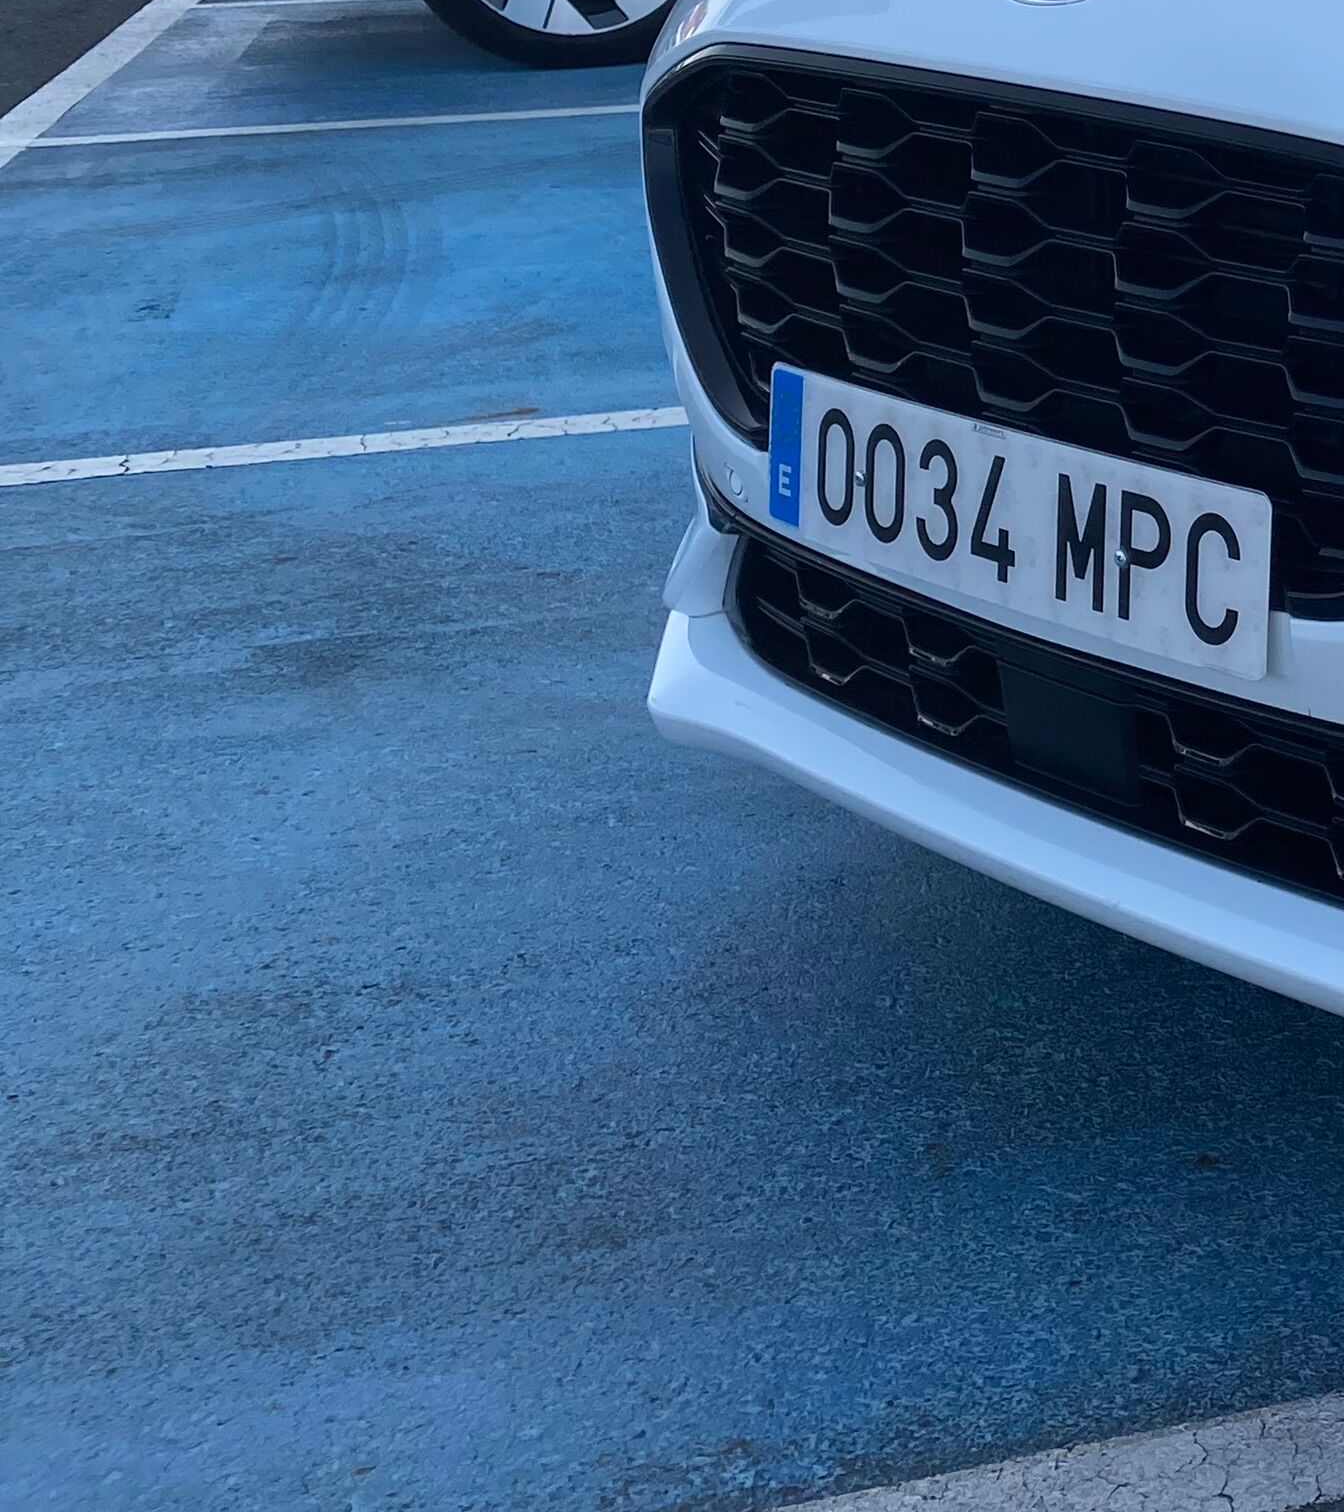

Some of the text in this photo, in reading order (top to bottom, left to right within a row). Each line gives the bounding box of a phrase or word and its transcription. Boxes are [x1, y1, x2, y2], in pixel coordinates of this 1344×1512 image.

[777, 408, 1241, 646] E 0034 MPC
